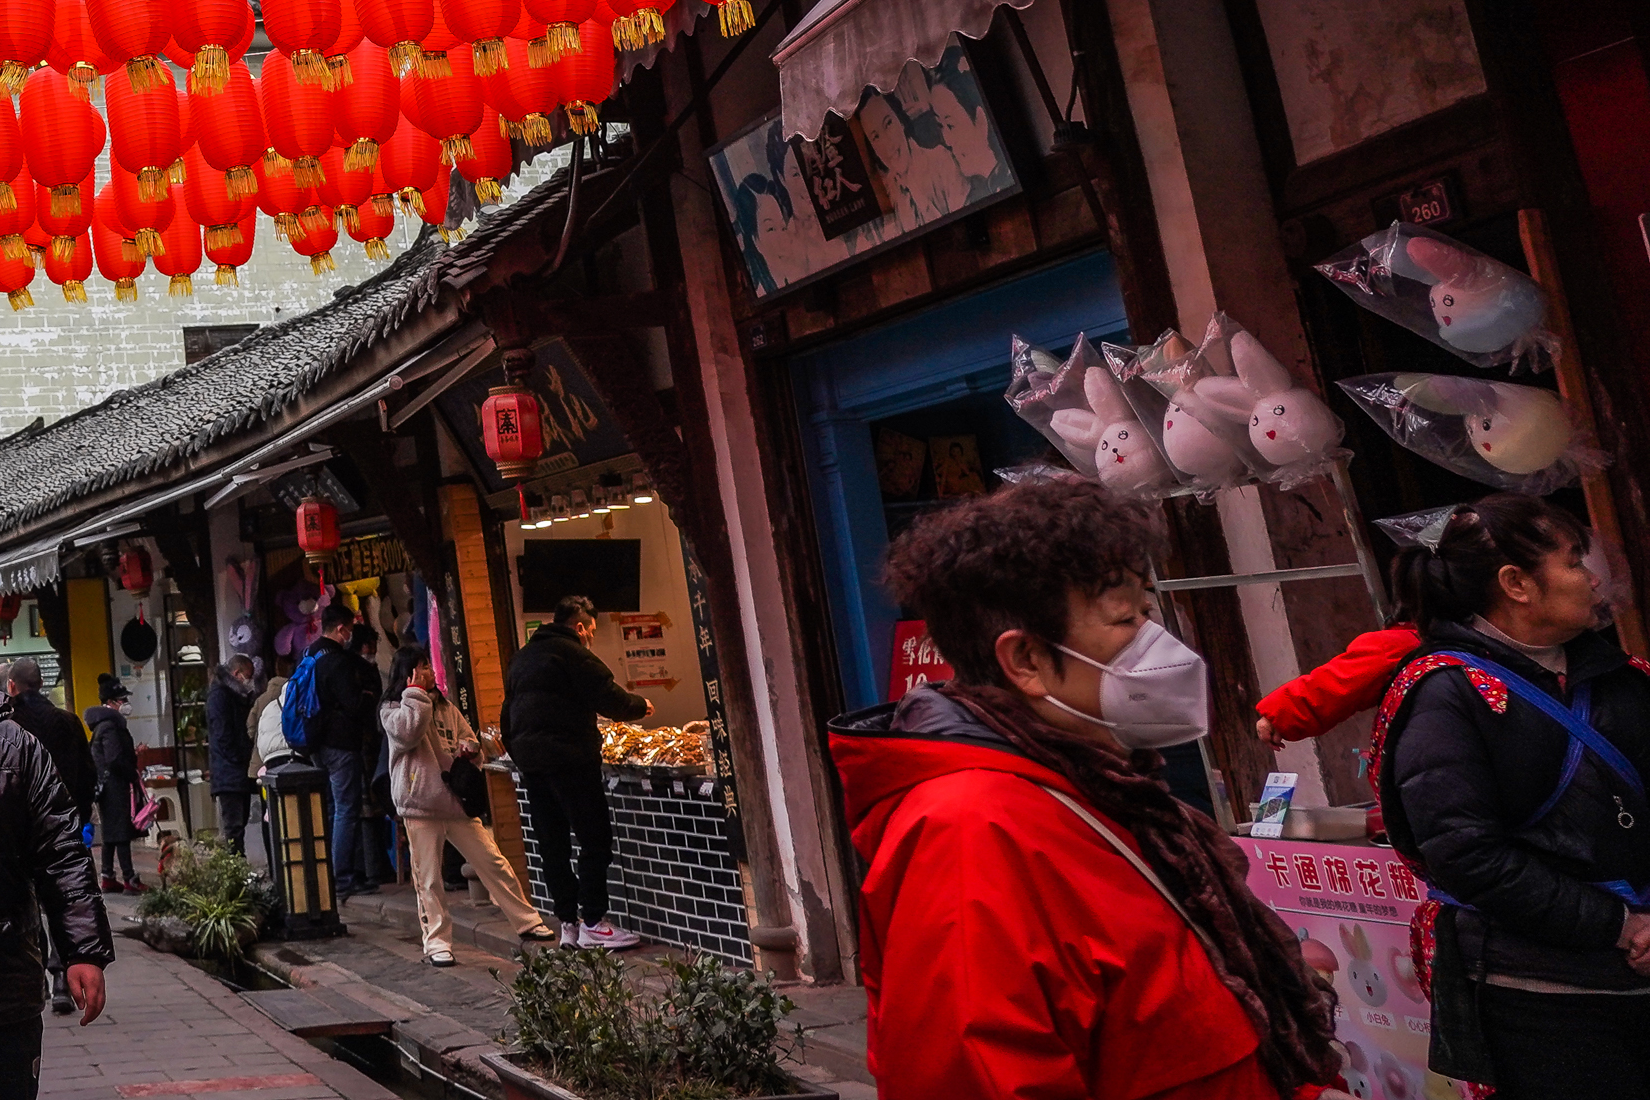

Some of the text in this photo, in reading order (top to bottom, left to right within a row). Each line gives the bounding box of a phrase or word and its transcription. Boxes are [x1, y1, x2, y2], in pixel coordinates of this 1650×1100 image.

[1411, 200, 1441, 223] 260
[704, 678, 739, 818] 回味经典
[1265, 851, 1421, 903] 卡通棉花糖
[1366, 1010, 1391, 1027] 小白兔
